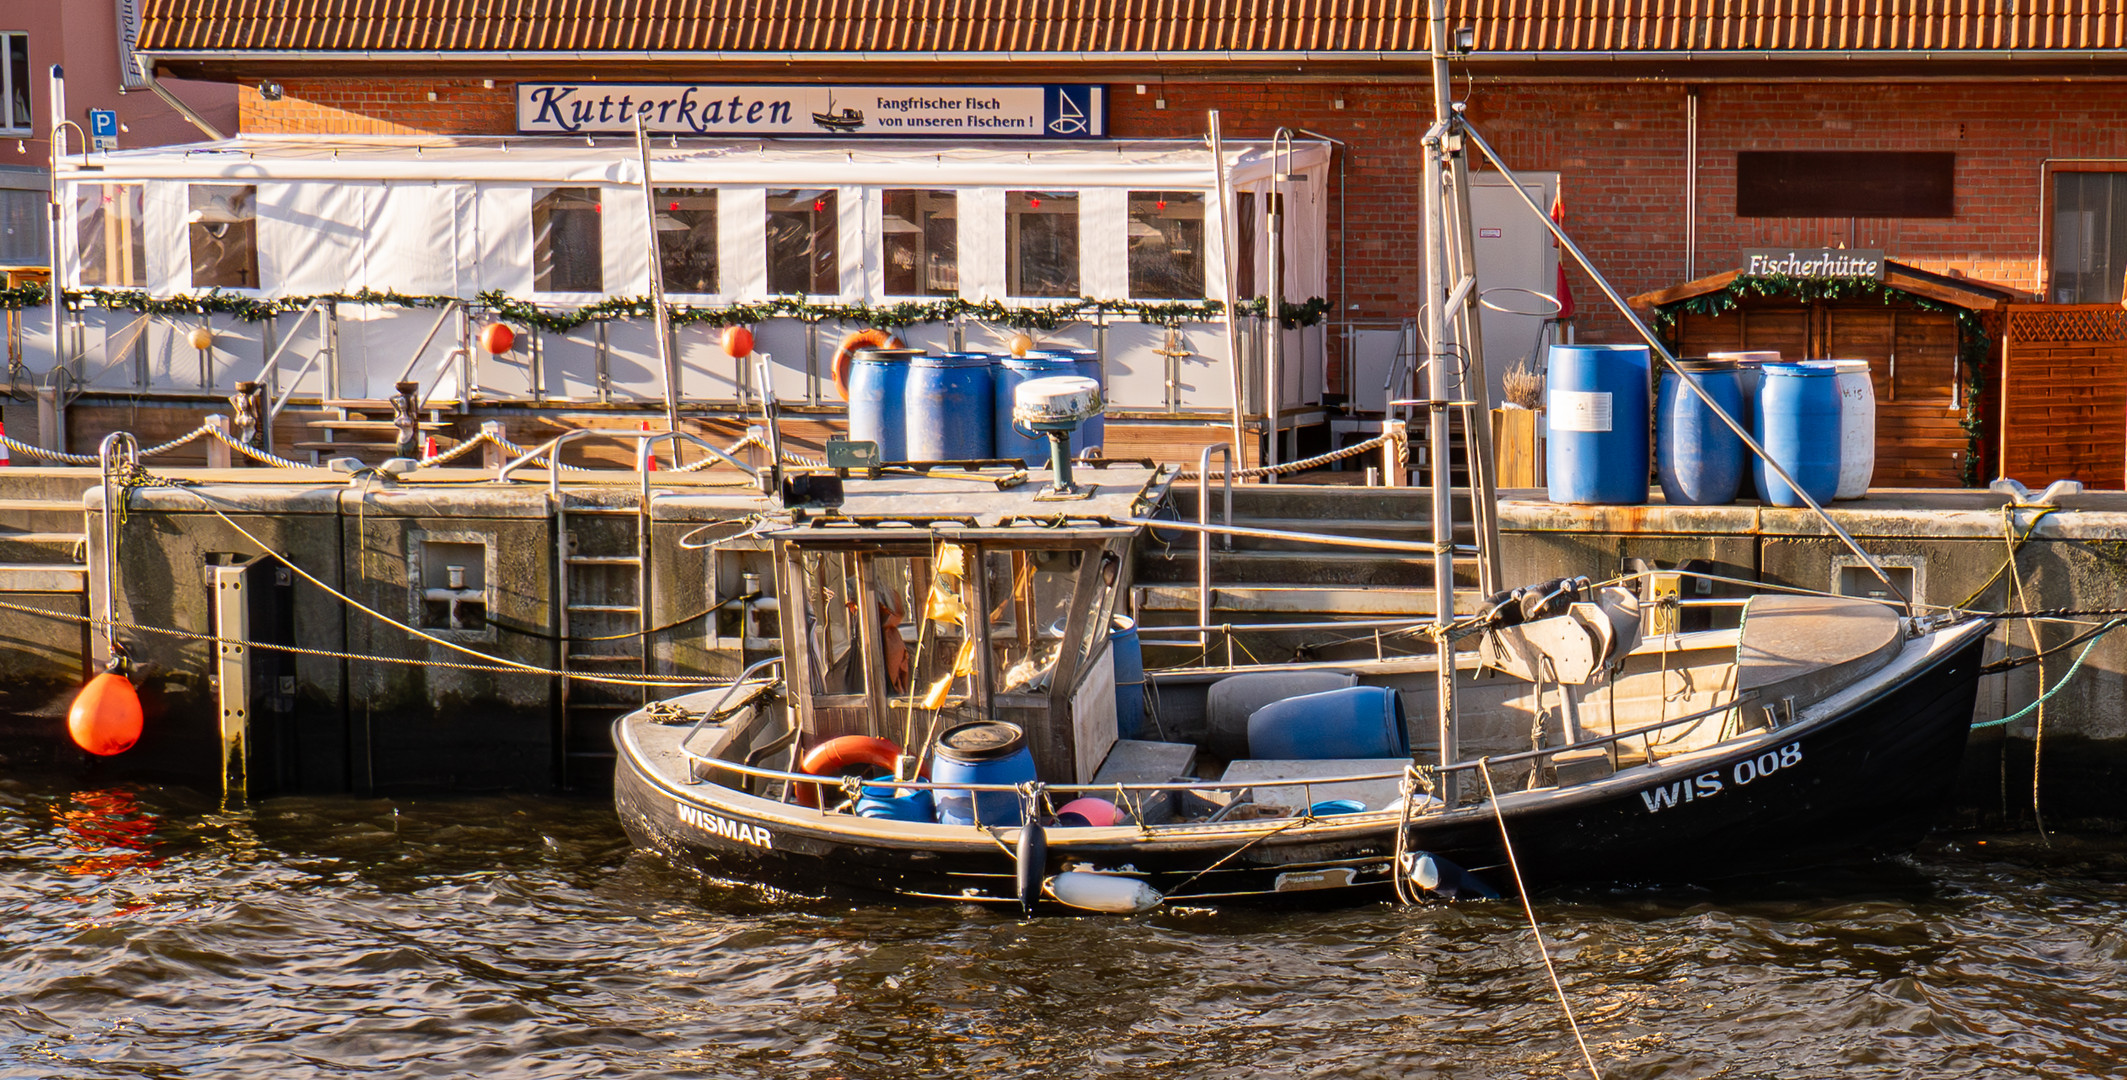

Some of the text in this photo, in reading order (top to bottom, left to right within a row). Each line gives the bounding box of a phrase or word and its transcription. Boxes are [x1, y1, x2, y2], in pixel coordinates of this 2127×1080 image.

[530, 86, 793, 133] Kutterkaten
[877, 97, 1001, 112] Fangfrischer Fisch
[97, 114, 110, 134] P
[878, 115, 1033, 128] von unseren Fischern !
[1748, 252, 1878, 277] Fischerhütte
[1640, 741, 1803, 813] WIS 008
[677, 802, 773, 850] WISMAR
